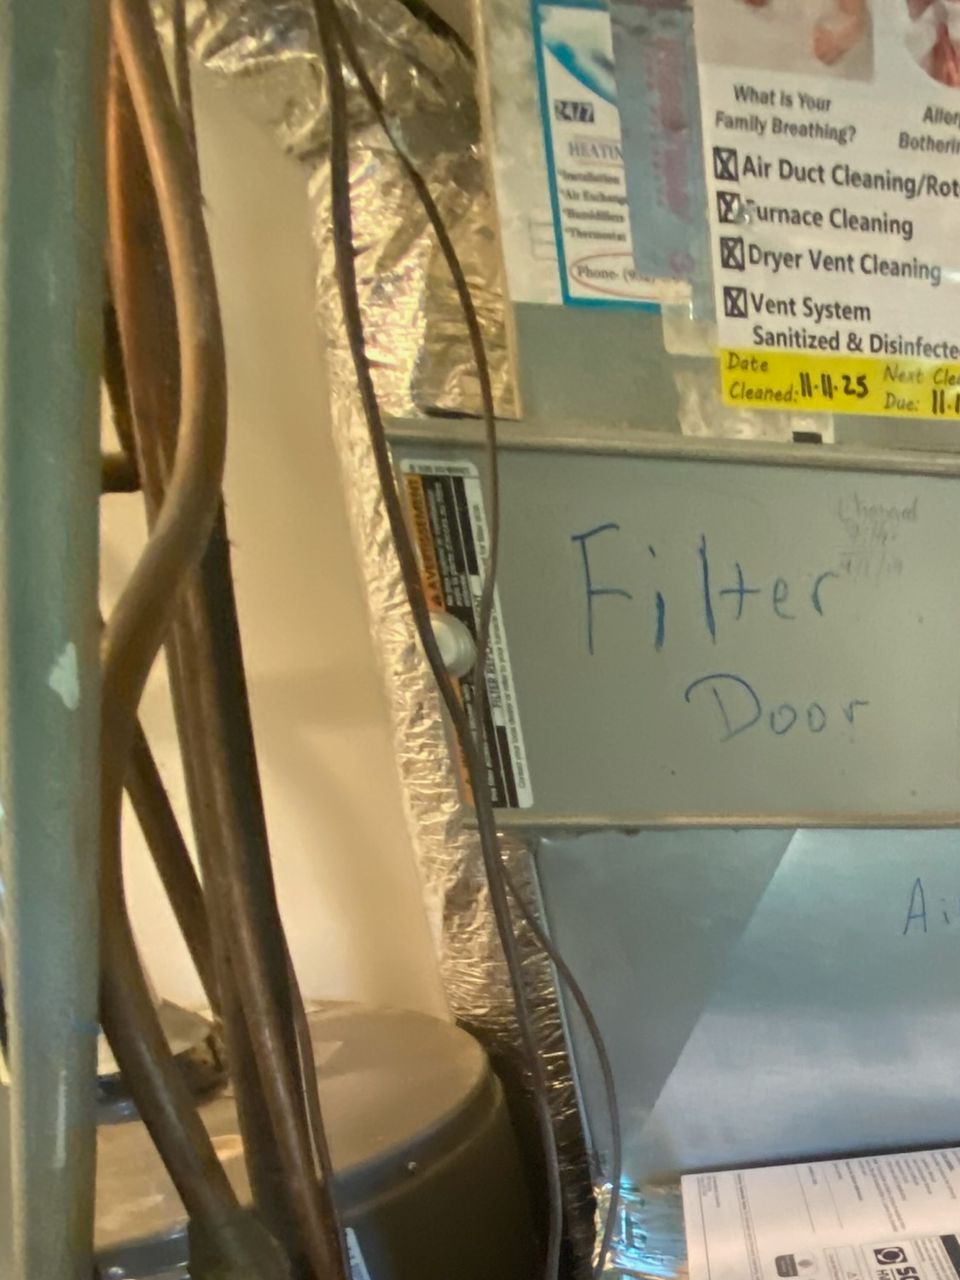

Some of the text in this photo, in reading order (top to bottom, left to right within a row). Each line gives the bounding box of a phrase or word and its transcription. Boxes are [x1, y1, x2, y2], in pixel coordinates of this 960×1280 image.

[733, 84, 775, 107] What
[798, 92, 832, 112] Your
[715, 110, 857, 146] Family Breathing?
[742, 155, 772, 178] Air
[778, 158, 825, 186] Duct
[829, 207, 914, 241] Cleaning
[750, 243, 942, 287] Dryer Vent Cleaning
[751, 292, 871, 323] Vent System
[752, 324, 840, 352] Sanitized
[846, 332, 864, 353] &
[728, 351, 769, 372] Date
[883, 364, 924, 384] Next
[571, 522, 840, 656] Filter
[485, 677, 501, 708] FILTER
[684, 673, 869, 744] Door
